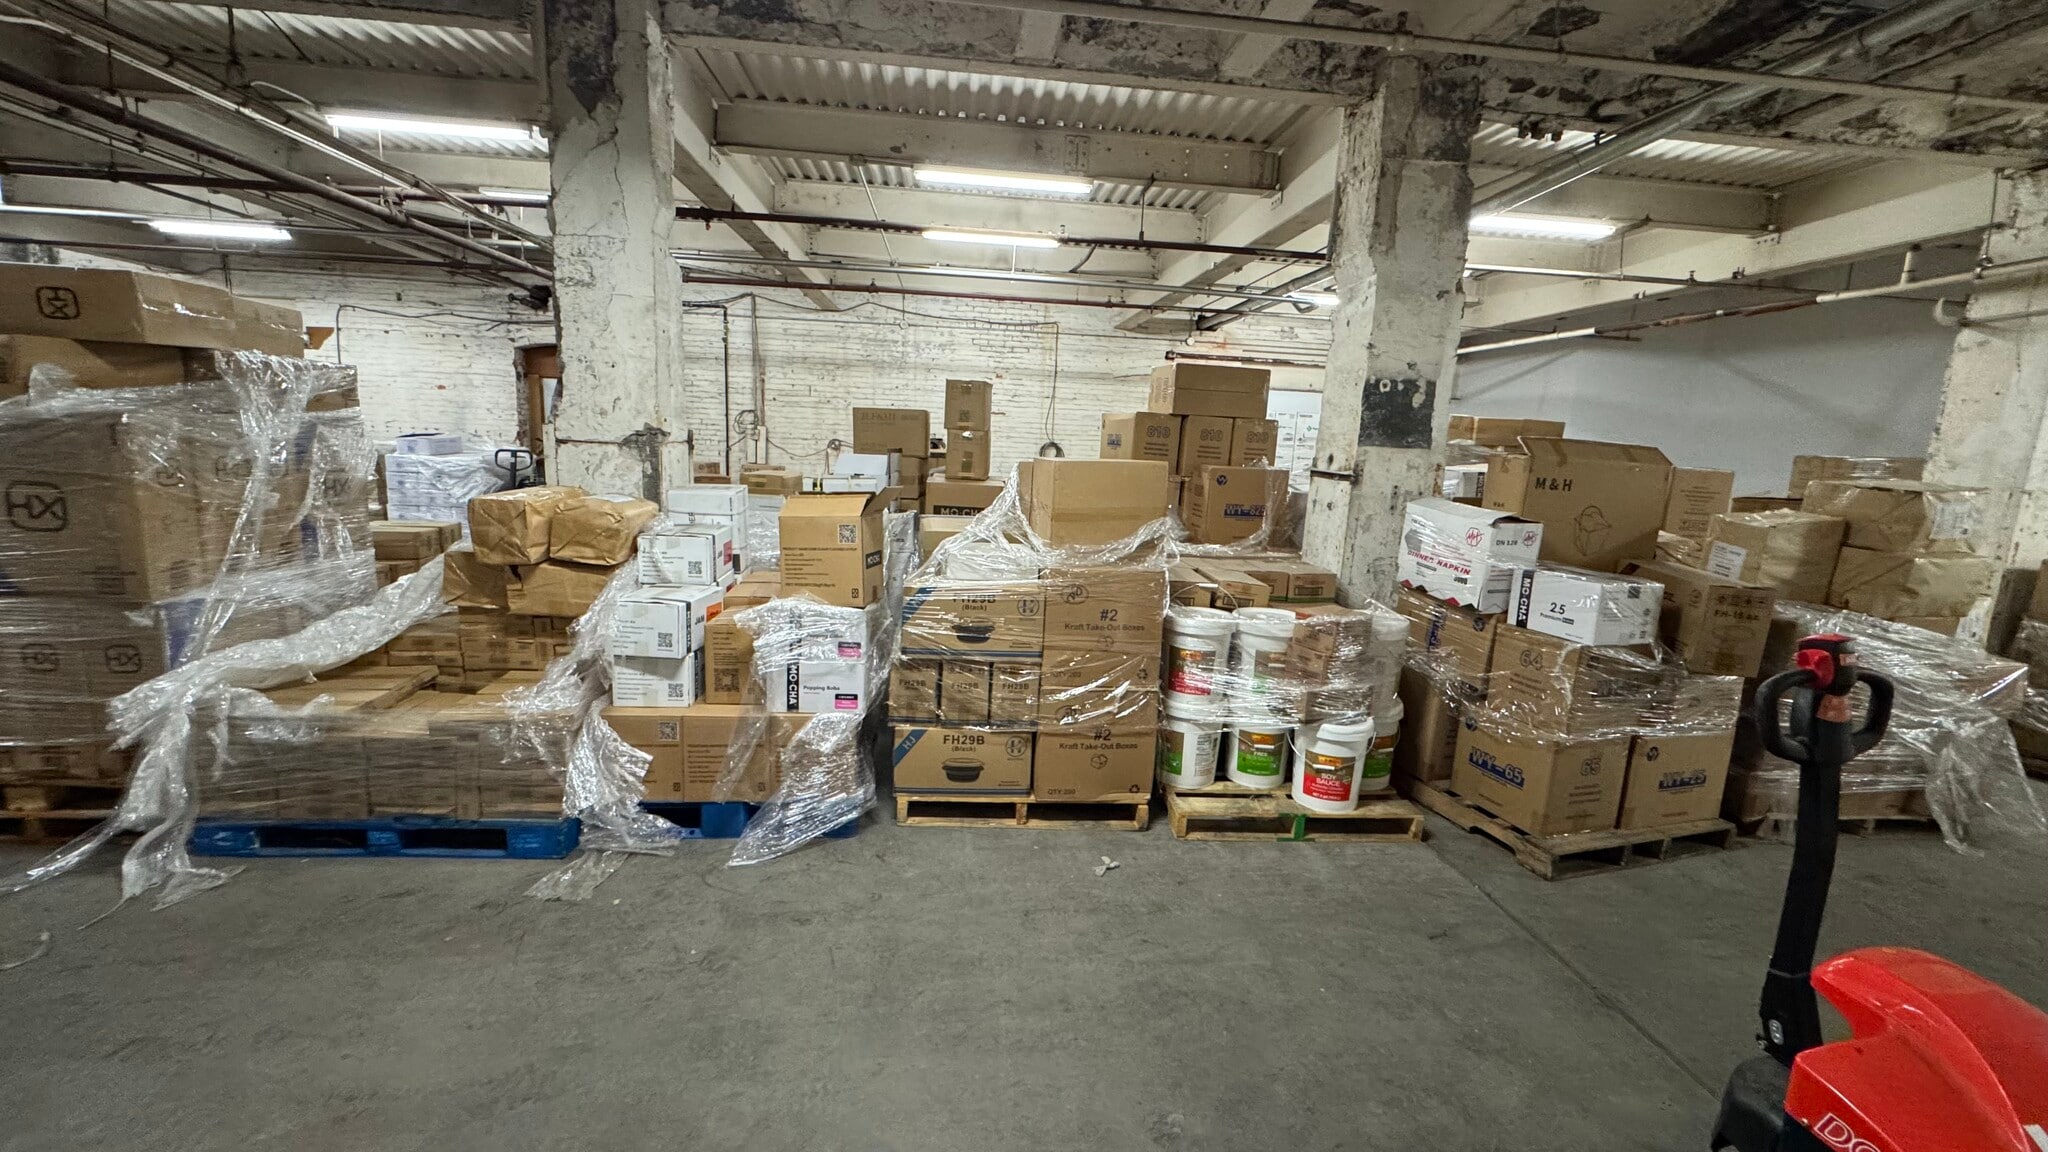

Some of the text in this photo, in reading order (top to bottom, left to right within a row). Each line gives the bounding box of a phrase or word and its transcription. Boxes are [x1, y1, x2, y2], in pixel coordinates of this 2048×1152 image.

[1535, 477, 1573, 492] M & H
[1437, 559, 1471, 576] NAPKIN
[1100, 609, 1118, 621] #2
[1521, 650, 1543, 671] 64
[943, 734, 985, 745] FH29B
[1094, 729, 1111, 741] #2
[902, 736, 917, 750] HJ
